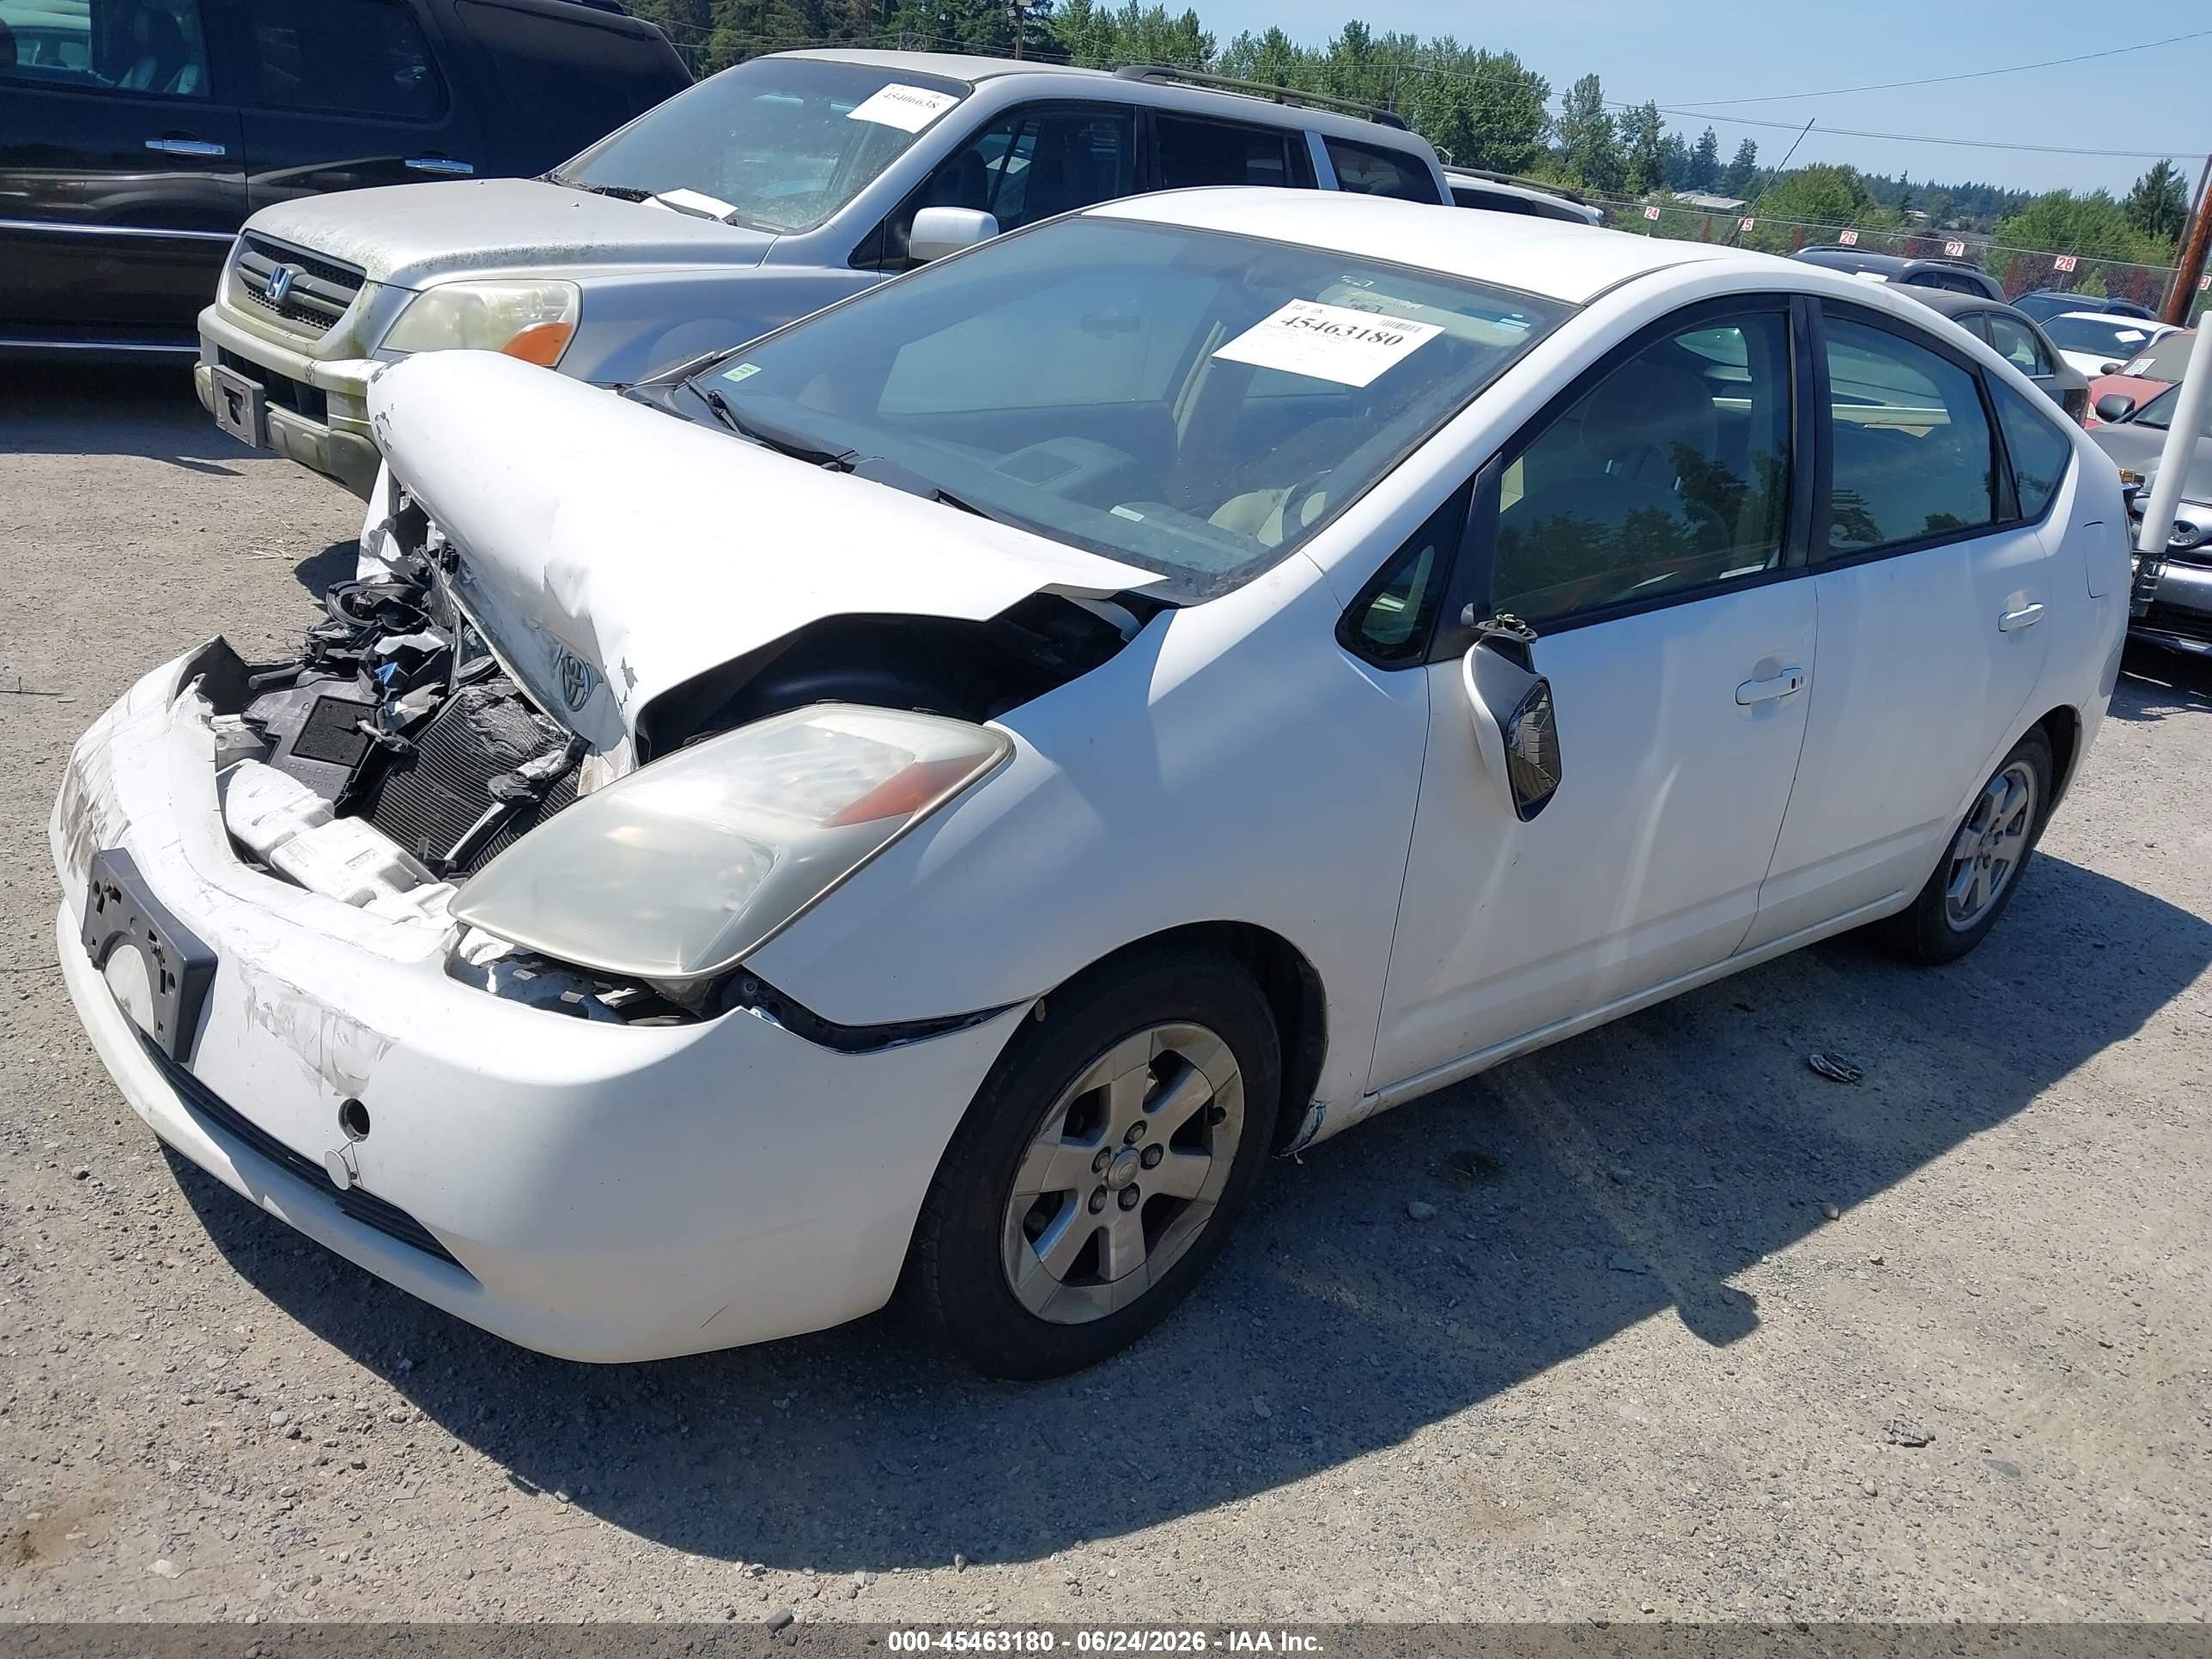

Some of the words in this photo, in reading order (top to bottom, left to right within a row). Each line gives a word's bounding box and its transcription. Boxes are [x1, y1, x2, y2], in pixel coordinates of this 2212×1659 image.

[1645, 207, 1658, 219] 24
[1841, 232, 1856, 244] 26
[1948, 243, 1962, 255] 27
[2057, 258, 2074, 270] 28
[1281, 315, 1405, 347] 45463180
